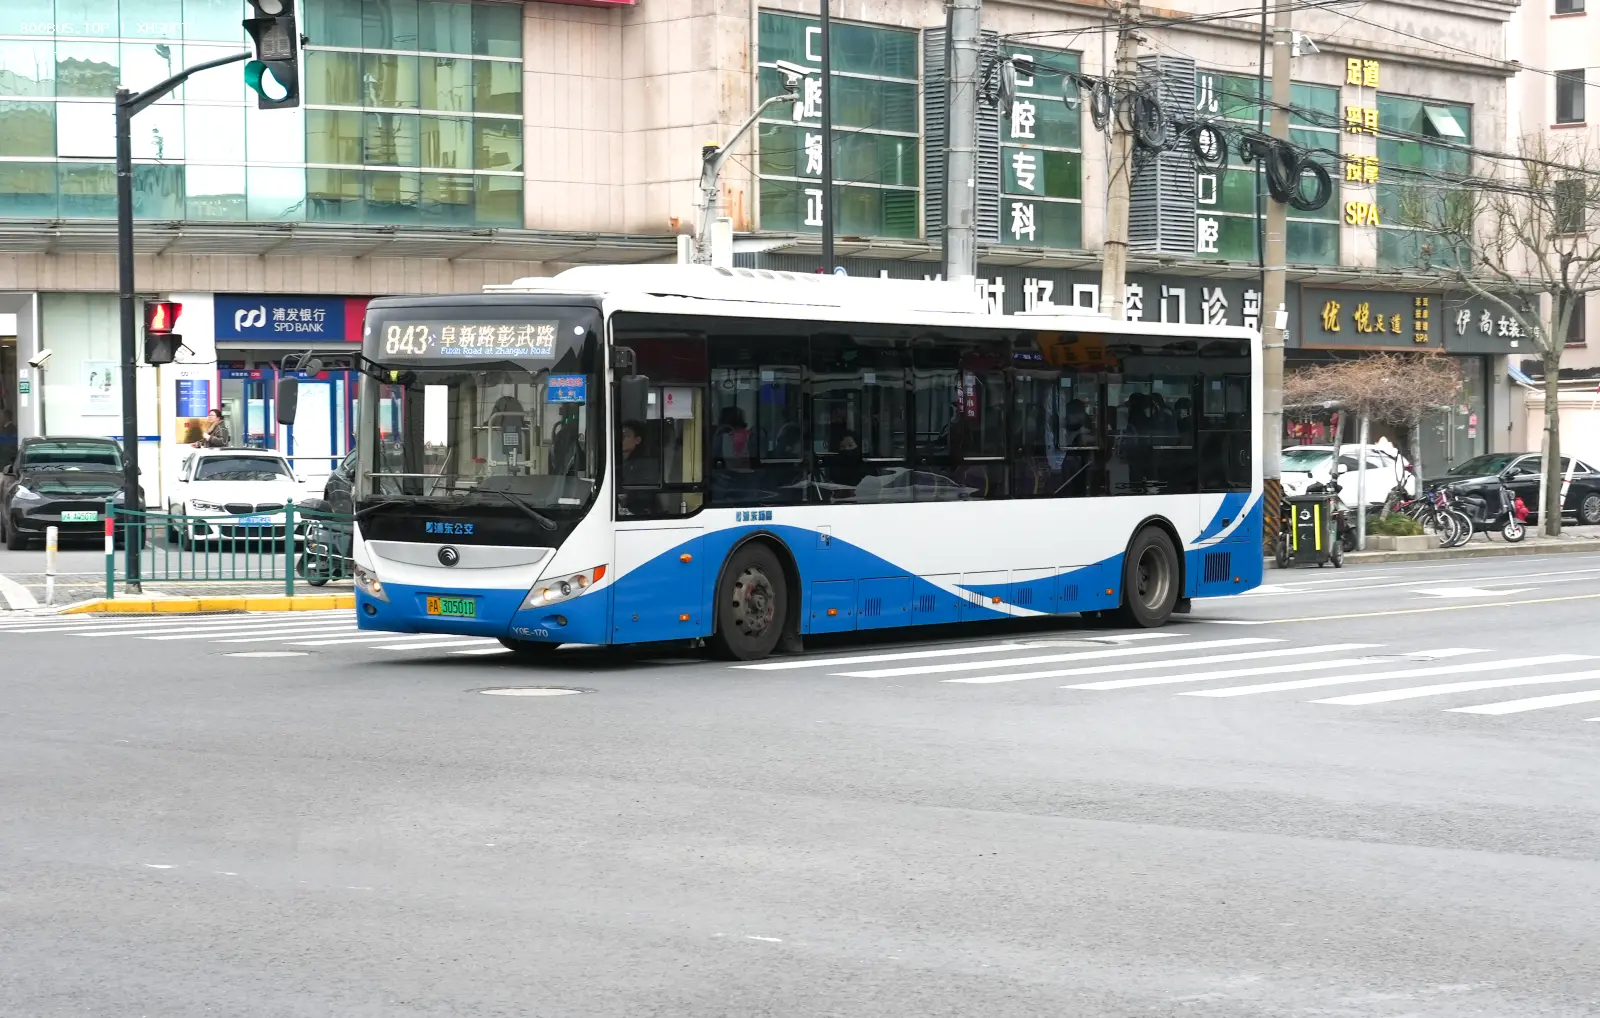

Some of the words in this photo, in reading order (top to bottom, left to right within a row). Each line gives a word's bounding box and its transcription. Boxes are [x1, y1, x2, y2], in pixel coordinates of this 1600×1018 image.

[1347, 58, 1379, 88] 足道
[1346, 202, 1380, 226] SPA
[272, 308, 326, 322] 浦发银行
[274, 322, 294, 333] SPD
[295, 322, 324, 333] BANK
[440, 324, 556, 348] 阜新路彰武路
[386, 325, 429, 354] 843
[441, 346, 461, 355] Fuxin
[463, 346, 482, 355] Road
[485, 346, 493, 355] at
[531, 346, 551, 355] Road
[434, 522, 474, 535] 浦东公交
[442, 599, 475, 616] 30501D
